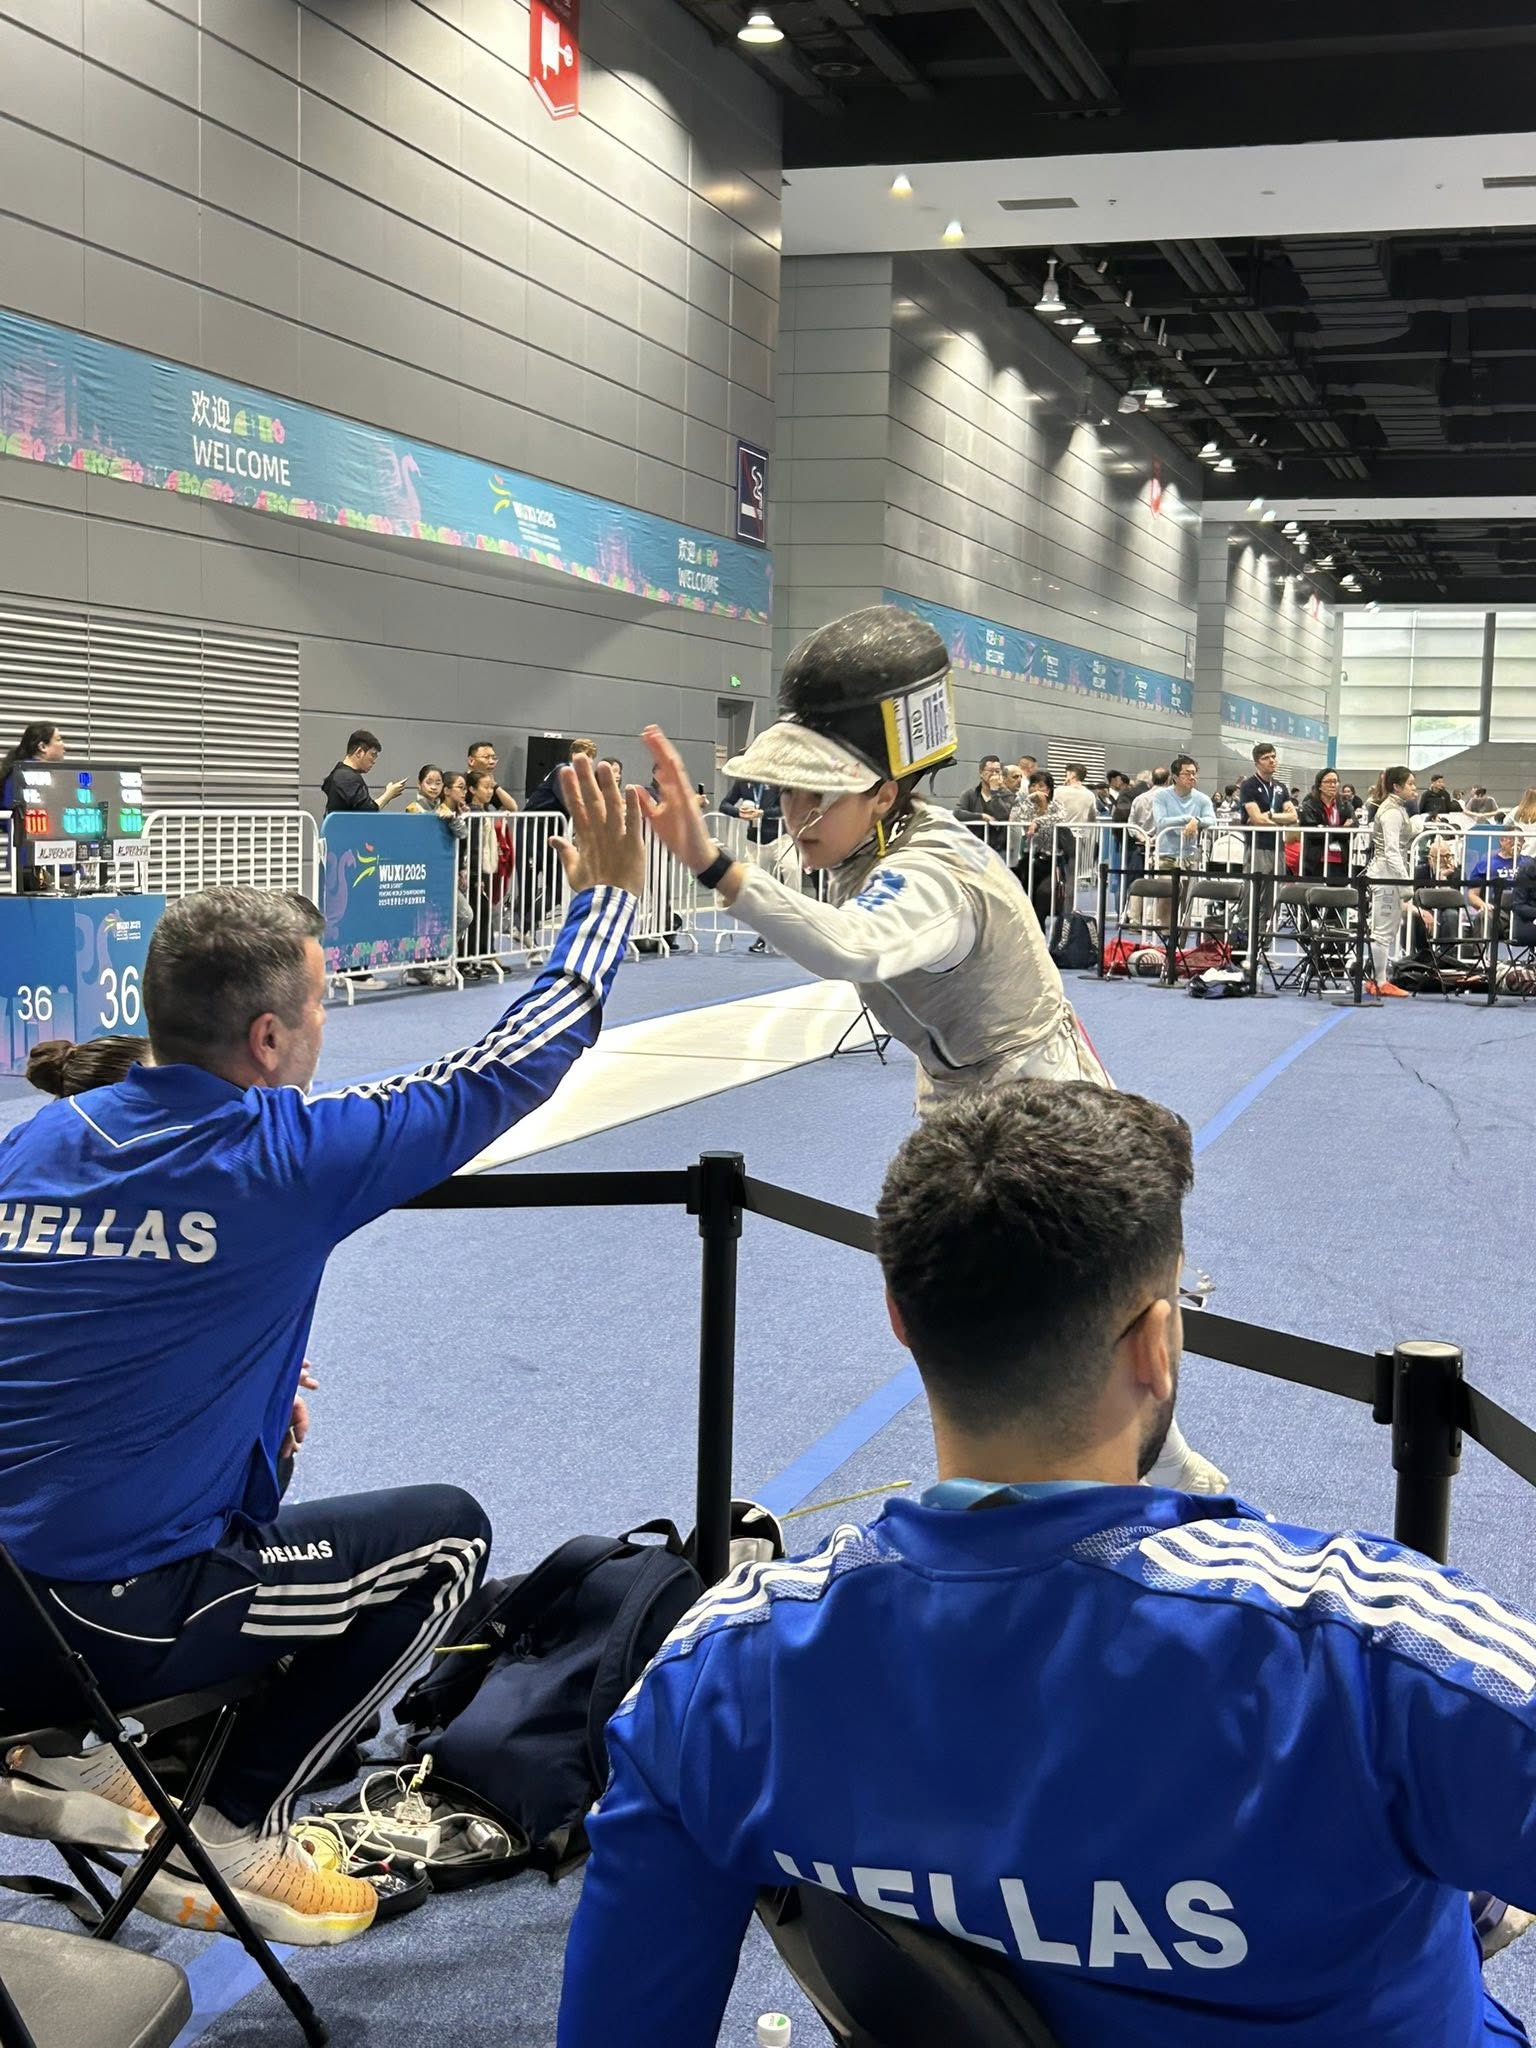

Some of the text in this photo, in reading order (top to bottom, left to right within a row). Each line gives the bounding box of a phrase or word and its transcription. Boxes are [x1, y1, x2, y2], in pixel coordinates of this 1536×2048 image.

[191, 389, 232, 434] 欢迎
[193, 435, 291, 487] WELCOME
[678, 567, 719, 595] WELCOME
[379, 864, 427, 882] WUXI 2025
[17, 985, 53, 1021] 36
[99, 965, 141, 1029] 36
[0, 1203, 218, 1264] HELLAS
[259, 1539, 333, 1564] HELLAS
